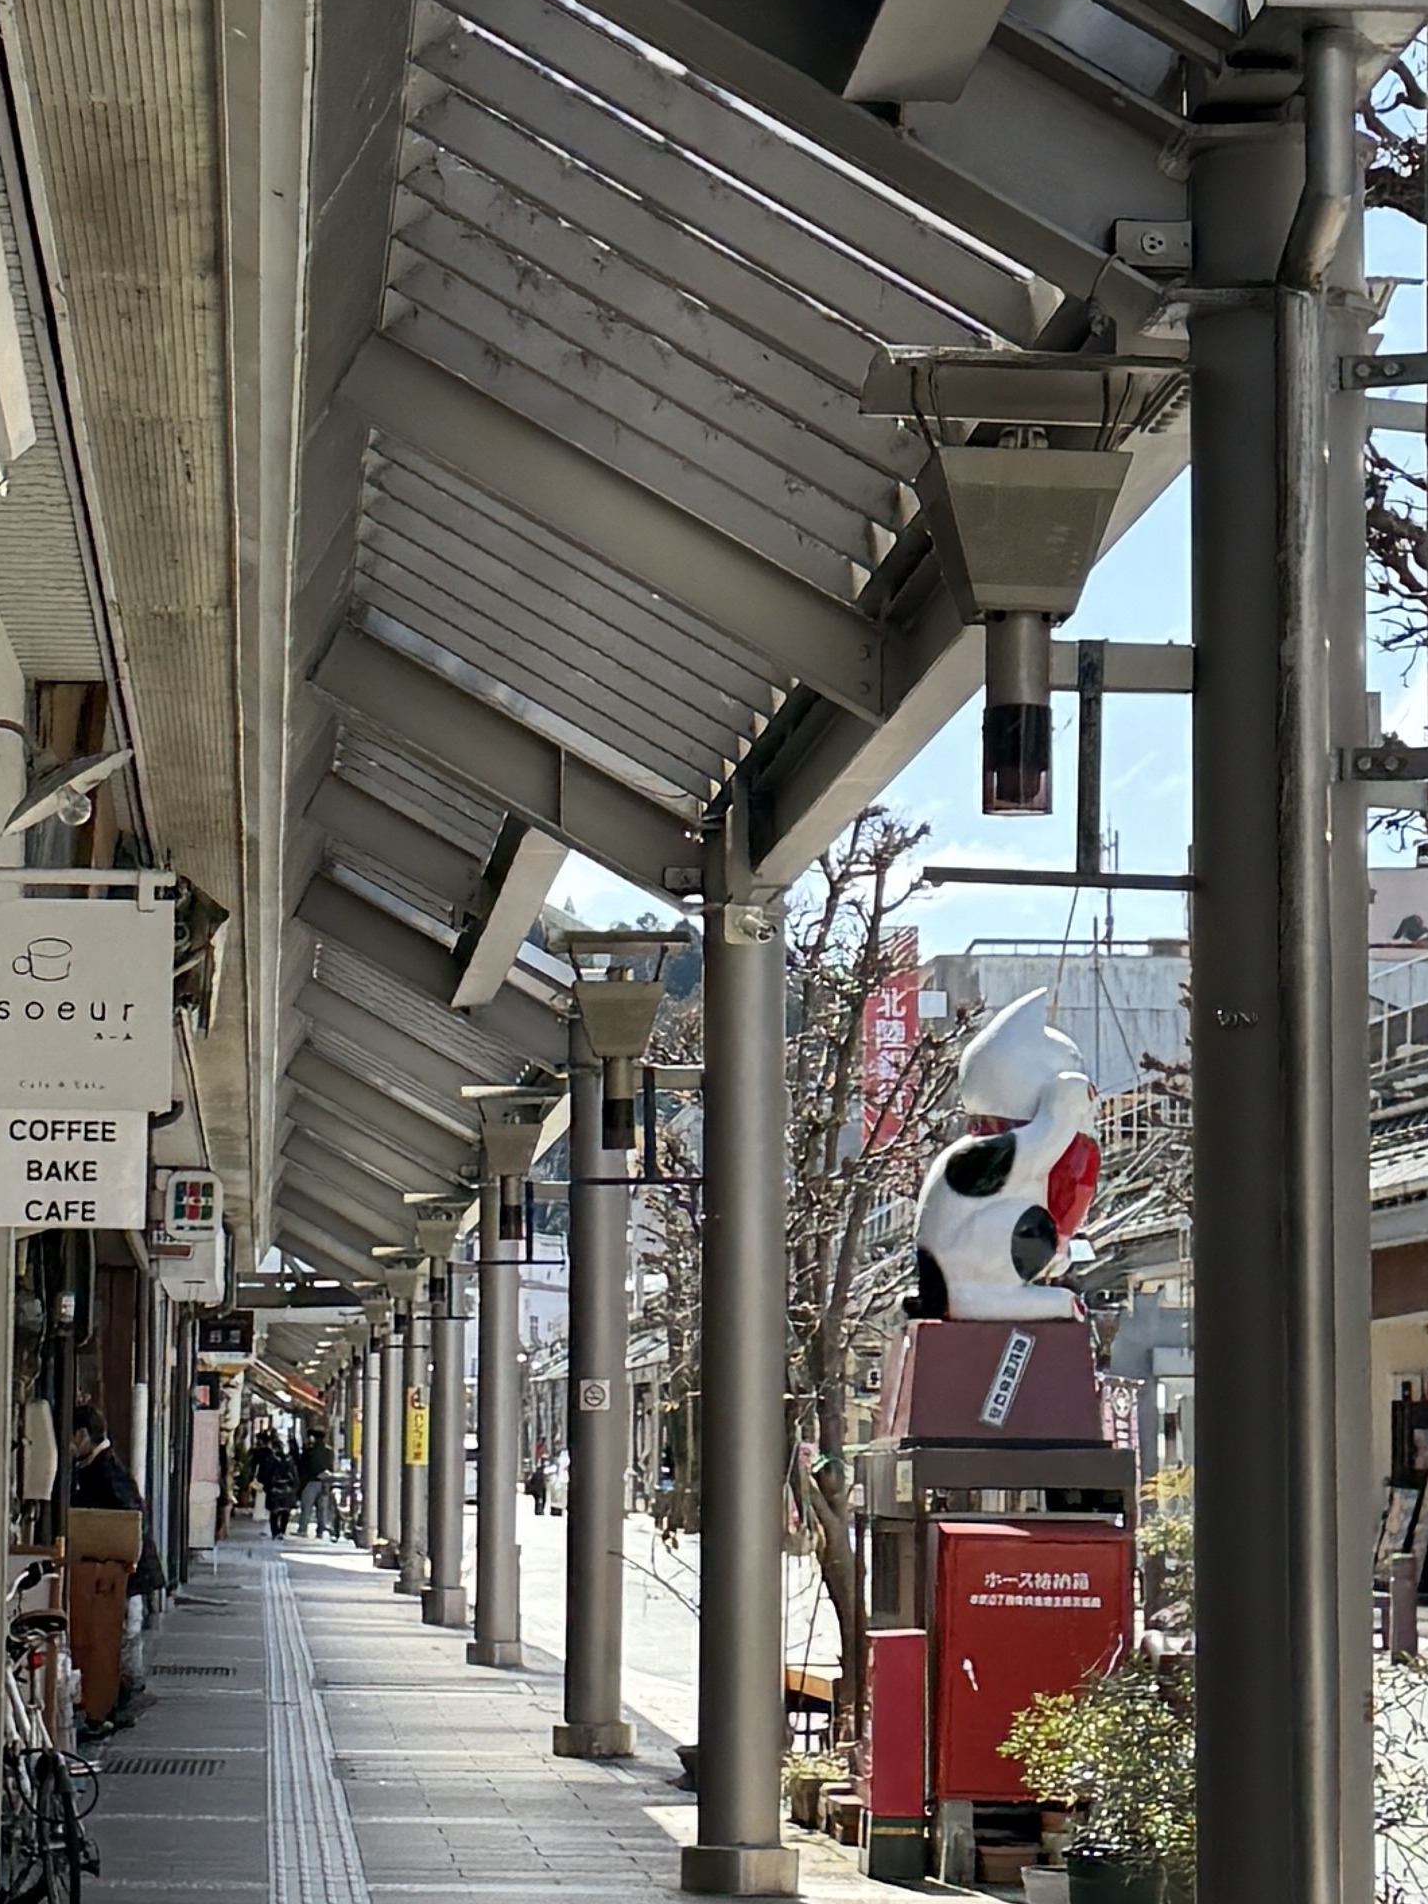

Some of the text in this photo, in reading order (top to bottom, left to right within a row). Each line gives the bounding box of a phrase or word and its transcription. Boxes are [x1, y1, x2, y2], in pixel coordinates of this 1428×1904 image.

[9, 1119, 117, 1143] COFFEE
[26, 1160, 98, 1182] BAKE
[24, 1200, 96, 1222] CAFE
